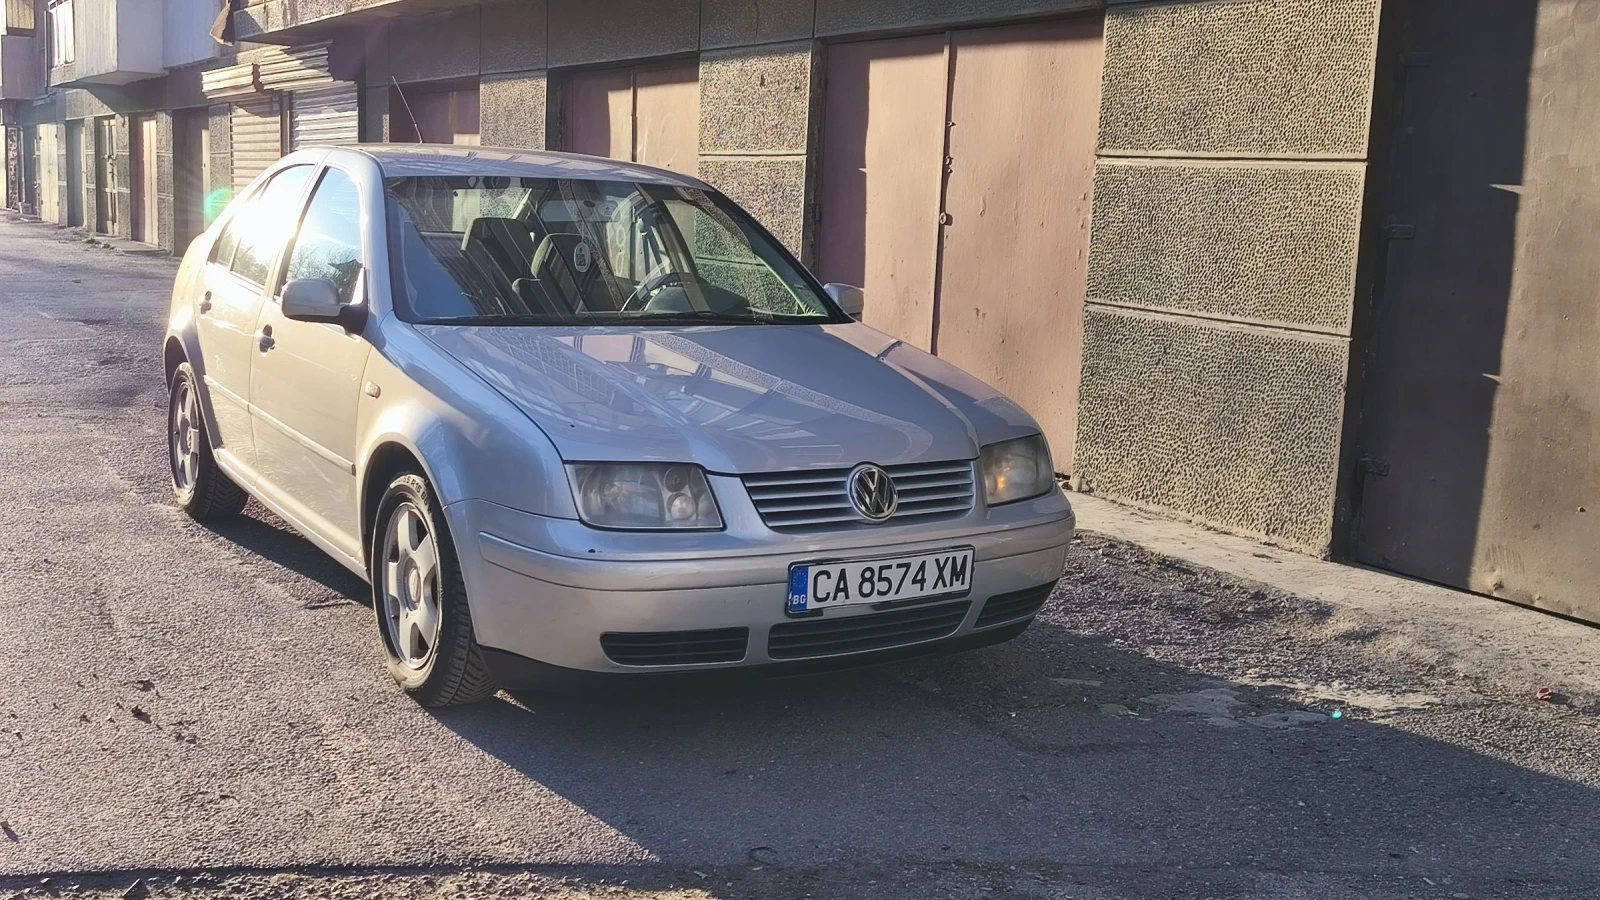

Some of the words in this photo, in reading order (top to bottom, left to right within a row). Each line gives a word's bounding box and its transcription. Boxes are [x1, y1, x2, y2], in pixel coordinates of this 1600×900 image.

[813, 568, 850, 602] CA
[858, 560, 927, 599] 8574
[932, 554, 969, 590] XM
[792, 594, 807, 605] BG
